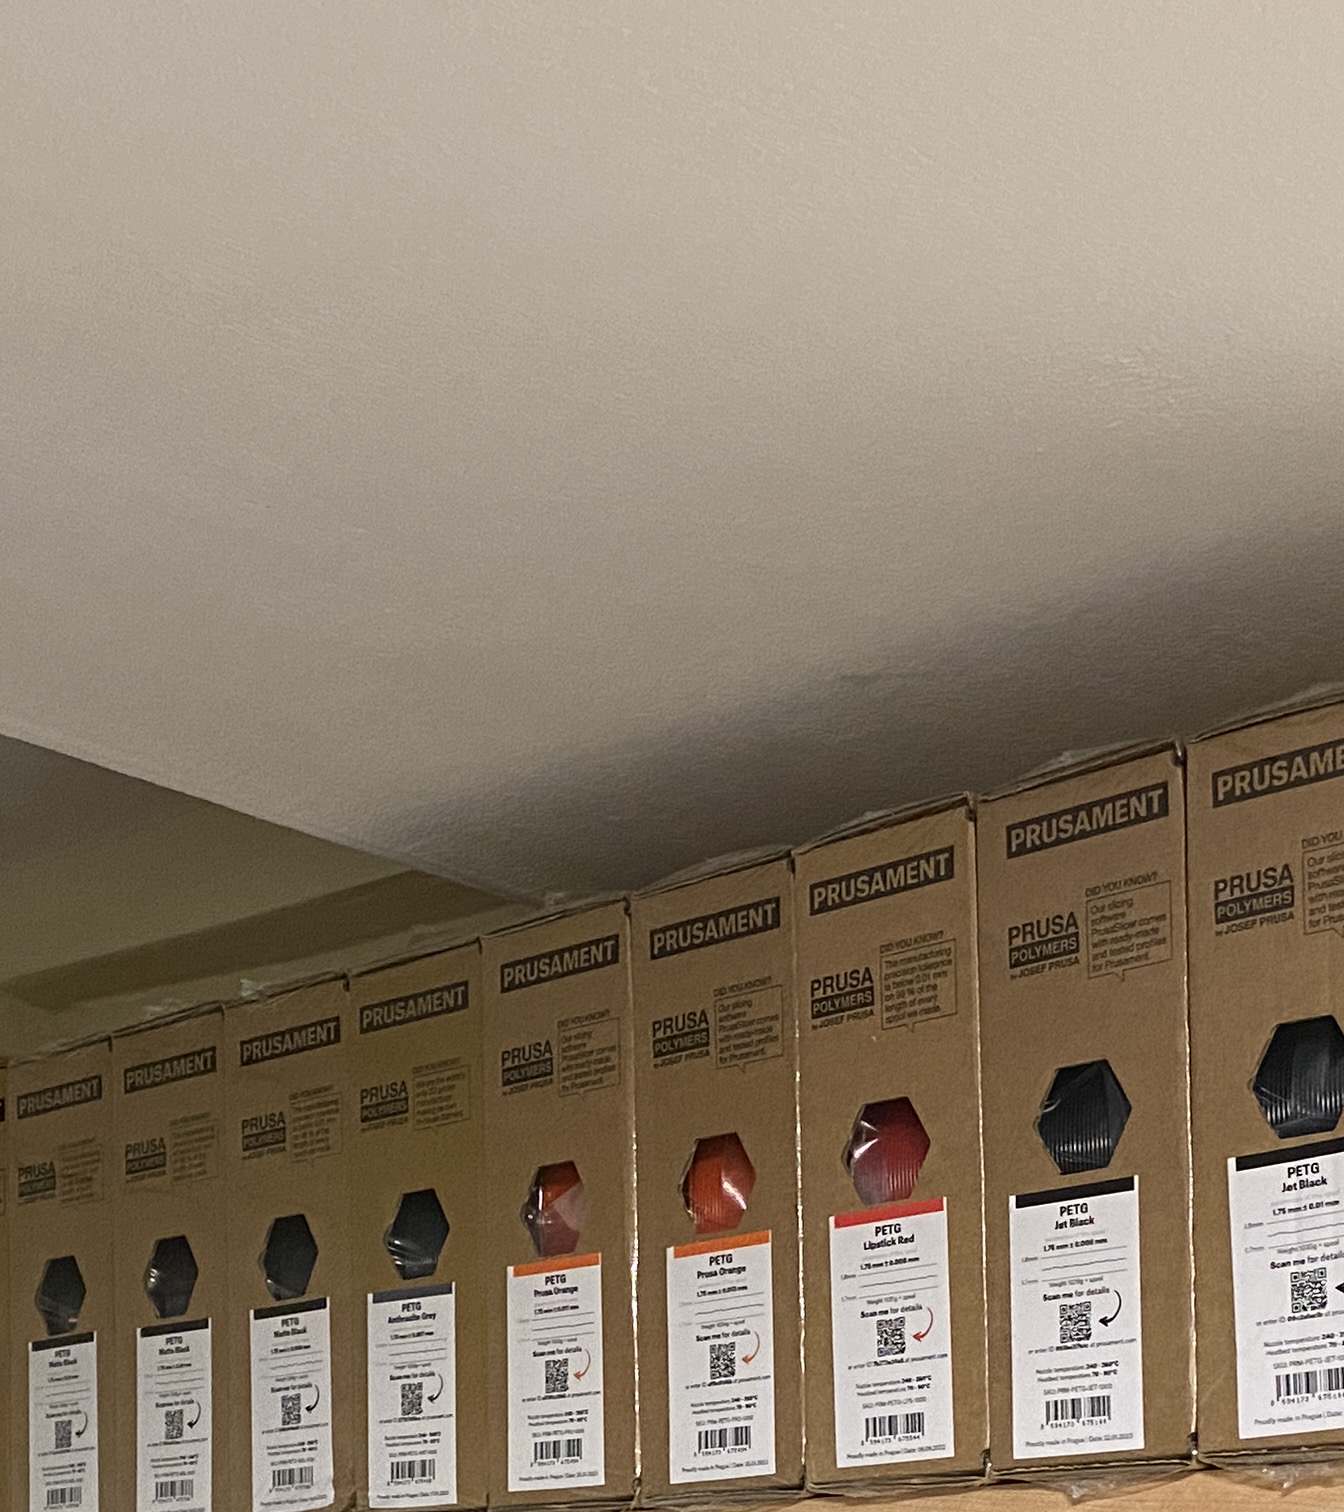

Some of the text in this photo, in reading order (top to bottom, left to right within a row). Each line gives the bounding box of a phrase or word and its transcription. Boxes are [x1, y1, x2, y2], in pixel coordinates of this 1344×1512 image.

[1010, 789, 1164, 853] PRUSAMENT
[1301, 837, 1319, 849] DID
[1321, 830, 1343, 844] YOU
[1307, 857, 1325, 867] Our
[813, 853, 950, 910] PRUSAMENT
[1103, 880, 1121, 893] YOU
[1123, 871, 1158, 887] KNOW?
[1214, 864, 1294, 900] PRUSA
[1217, 891, 1292, 919] POLYMERS
[653, 903, 776, 955] PRUSAMENT
[1008, 911, 1079, 946] PRUSA
[1224, 912, 1294, 936] JOSEF PRUSA
[1012, 937, 1077, 963] POLYMERS
[503, 940, 616, 988] PRUSAMENT
[1018, 956, 1080, 979] JOSEF PRUSA
[811, 967, 874, 999] PRUSA
[362, 986, 465, 1030] PRUSAMENT
[813, 991, 872, 1015] POLYMERS
[652, 1009, 709, 1038] PRUSA
[243, 1022, 337, 1062] PRUSAMENT
[501, 1040, 553, 1067] PRUSA
[655, 1032, 707, 1053] POLYMERS
[126, 1051, 213, 1091] PRUSAMENT
[19, 1079, 99, 1116] PRUSAMENT
[360, 1080, 408, 1104] PRUSA
[241, 1111, 286, 1134] PRUSA
[125, 1137, 166, 1159] PRUSA
[1287, 1162, 1320, 1178] PETG
[1281, 1176, 1328, 1192] Jet Black
[1060, 1203, 1088, 1217] PETG
[1273, 1208, 1286, 1216] 1.75
[875, 1223, 901, 1237] PETG
[1055, 1216, 1095, 1230] Jet Black
[863, 1234, 914, 1251] Lipstick Red
[709, 1254, 733, 1266] PETG
[1270, 1261, 1291, 1269] Scan
[1307, 1256, 1318, 1264] for
[545, 1274, 566, 1285] PETG
[697, 1266, 746, 1279] Prusa Orange
[1086, 1286, 1110, 1295] details
[402, 1302, 421, 1312] PETG
[860, 1311, 877, 1319] Scan
[900, 1303, 922, 1313] details
